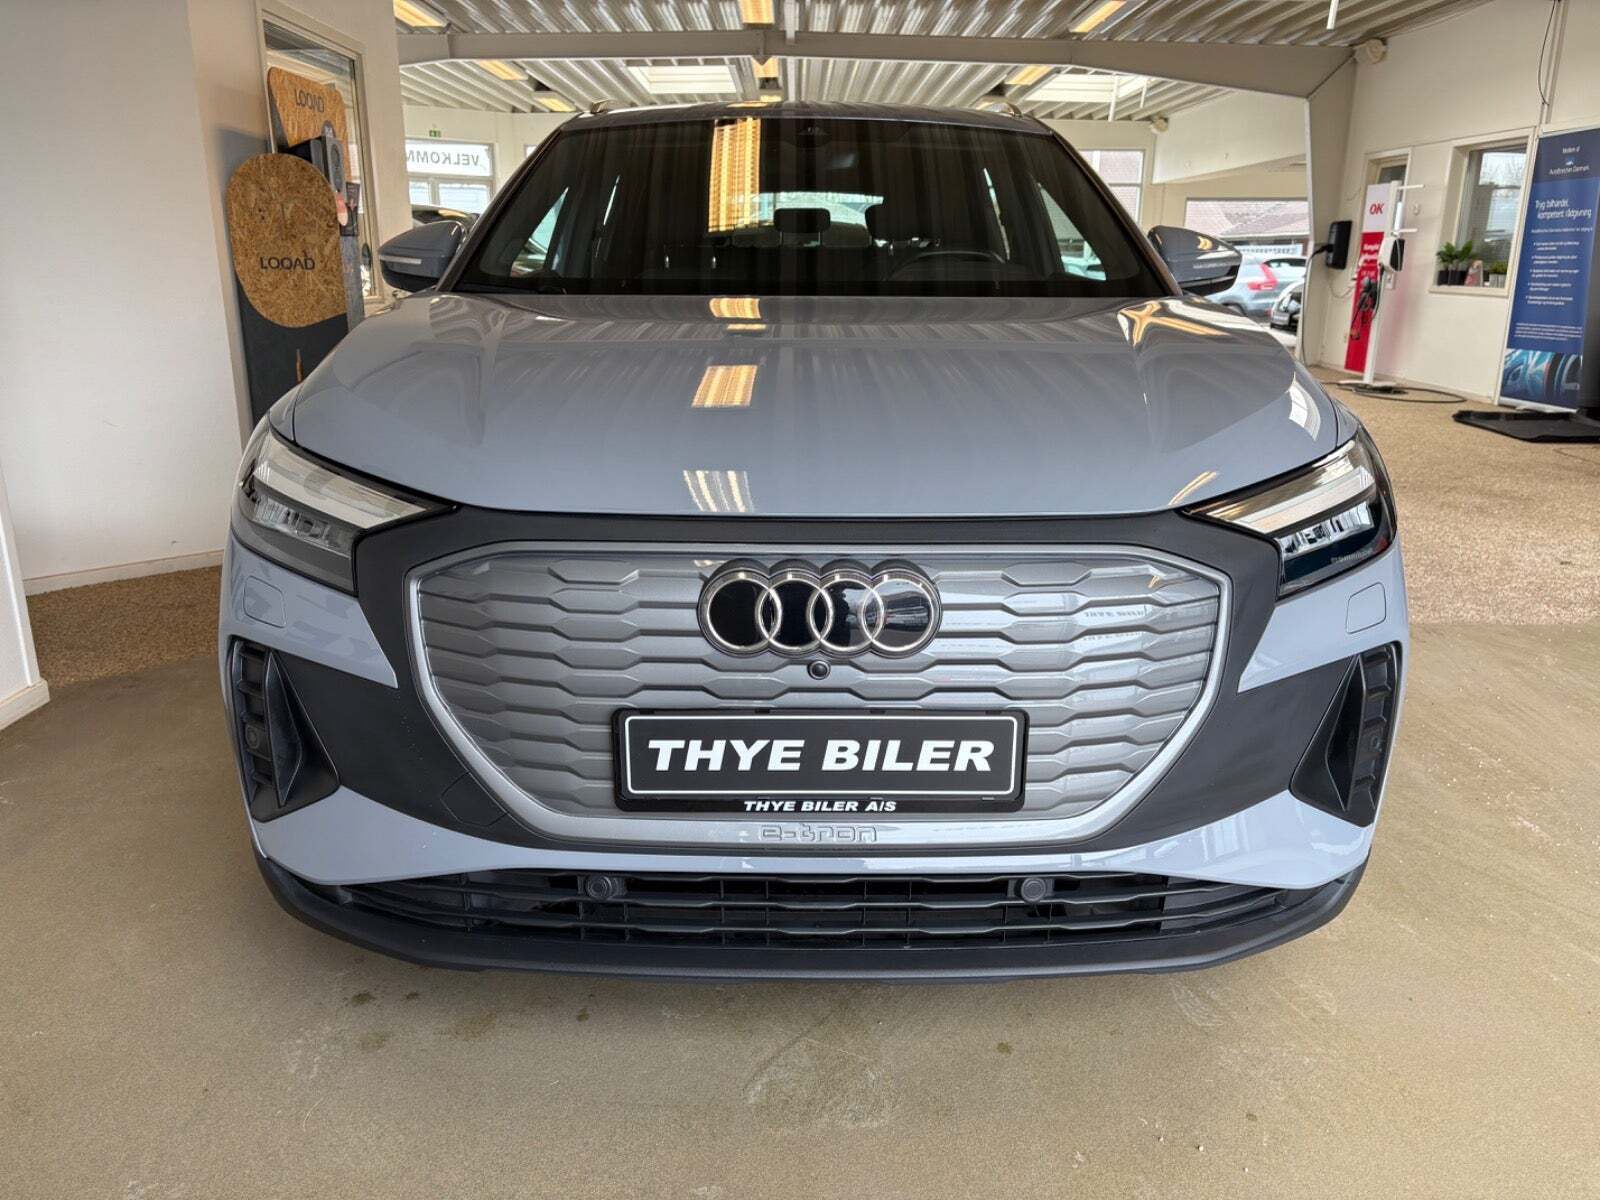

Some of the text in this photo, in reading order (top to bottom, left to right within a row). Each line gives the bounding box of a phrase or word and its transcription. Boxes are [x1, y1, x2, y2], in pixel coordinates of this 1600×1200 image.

[1369, 203, 1385, 215] OK
[648, 739, 994, 772] THYE BILER
[743, 801, 897, 812] THYE BILER A/S
